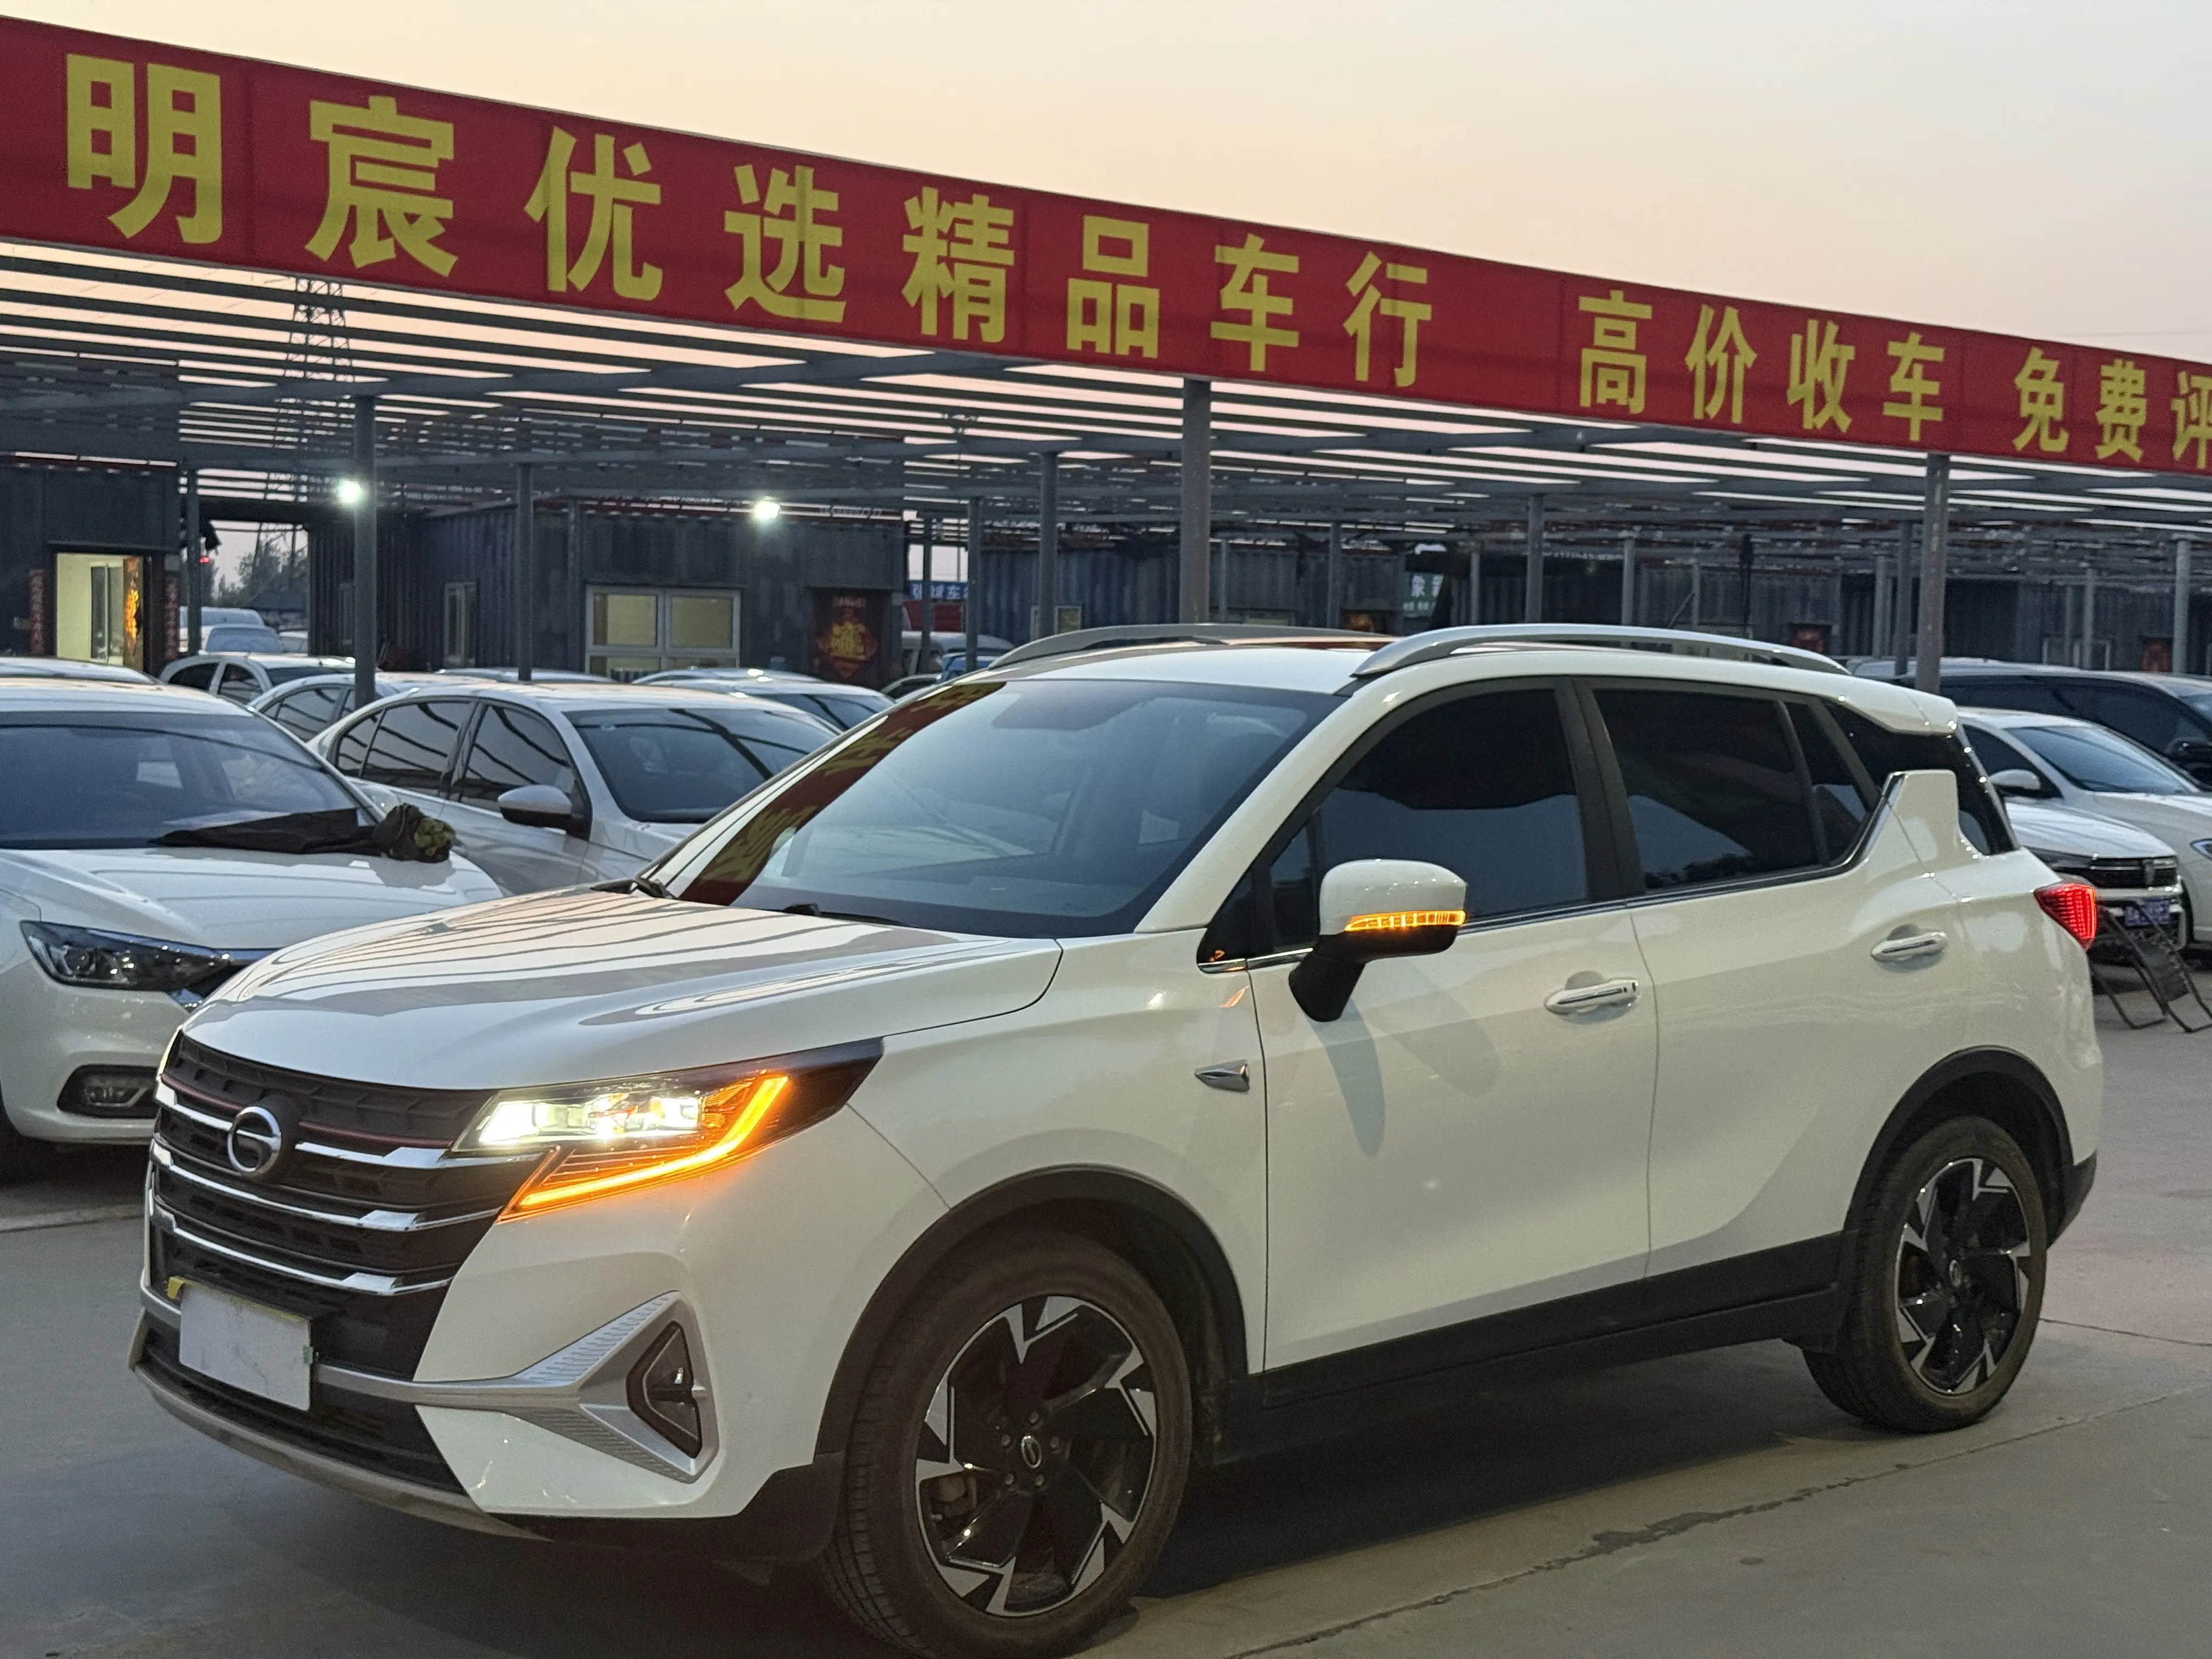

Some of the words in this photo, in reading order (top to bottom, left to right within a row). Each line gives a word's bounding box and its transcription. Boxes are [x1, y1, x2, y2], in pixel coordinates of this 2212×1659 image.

[66, 53, 1432, 387] 明宸优选精品车行
[1578, 290, 1945, 442] 高价收车
[2013, 348, 2212, 469] 免费评
